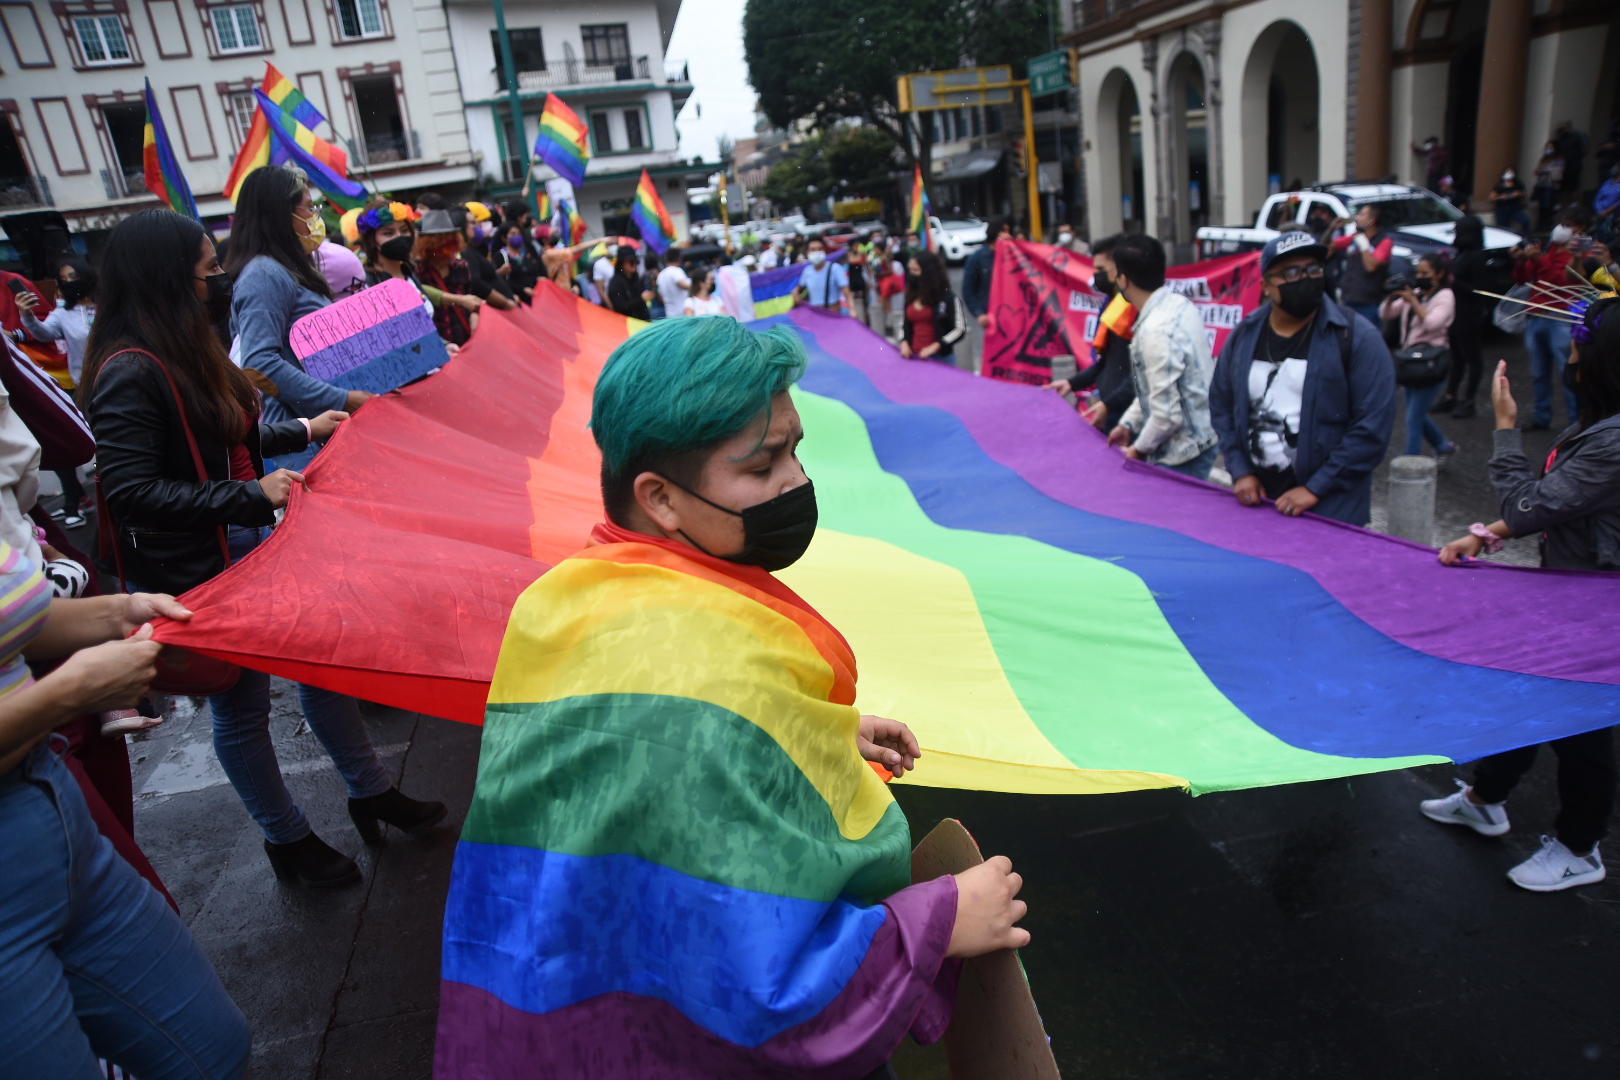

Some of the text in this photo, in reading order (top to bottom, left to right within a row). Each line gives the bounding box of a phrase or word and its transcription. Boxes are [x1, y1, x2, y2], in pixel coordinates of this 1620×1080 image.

[291, 284, 401, 359] AMAR NO DEBE
